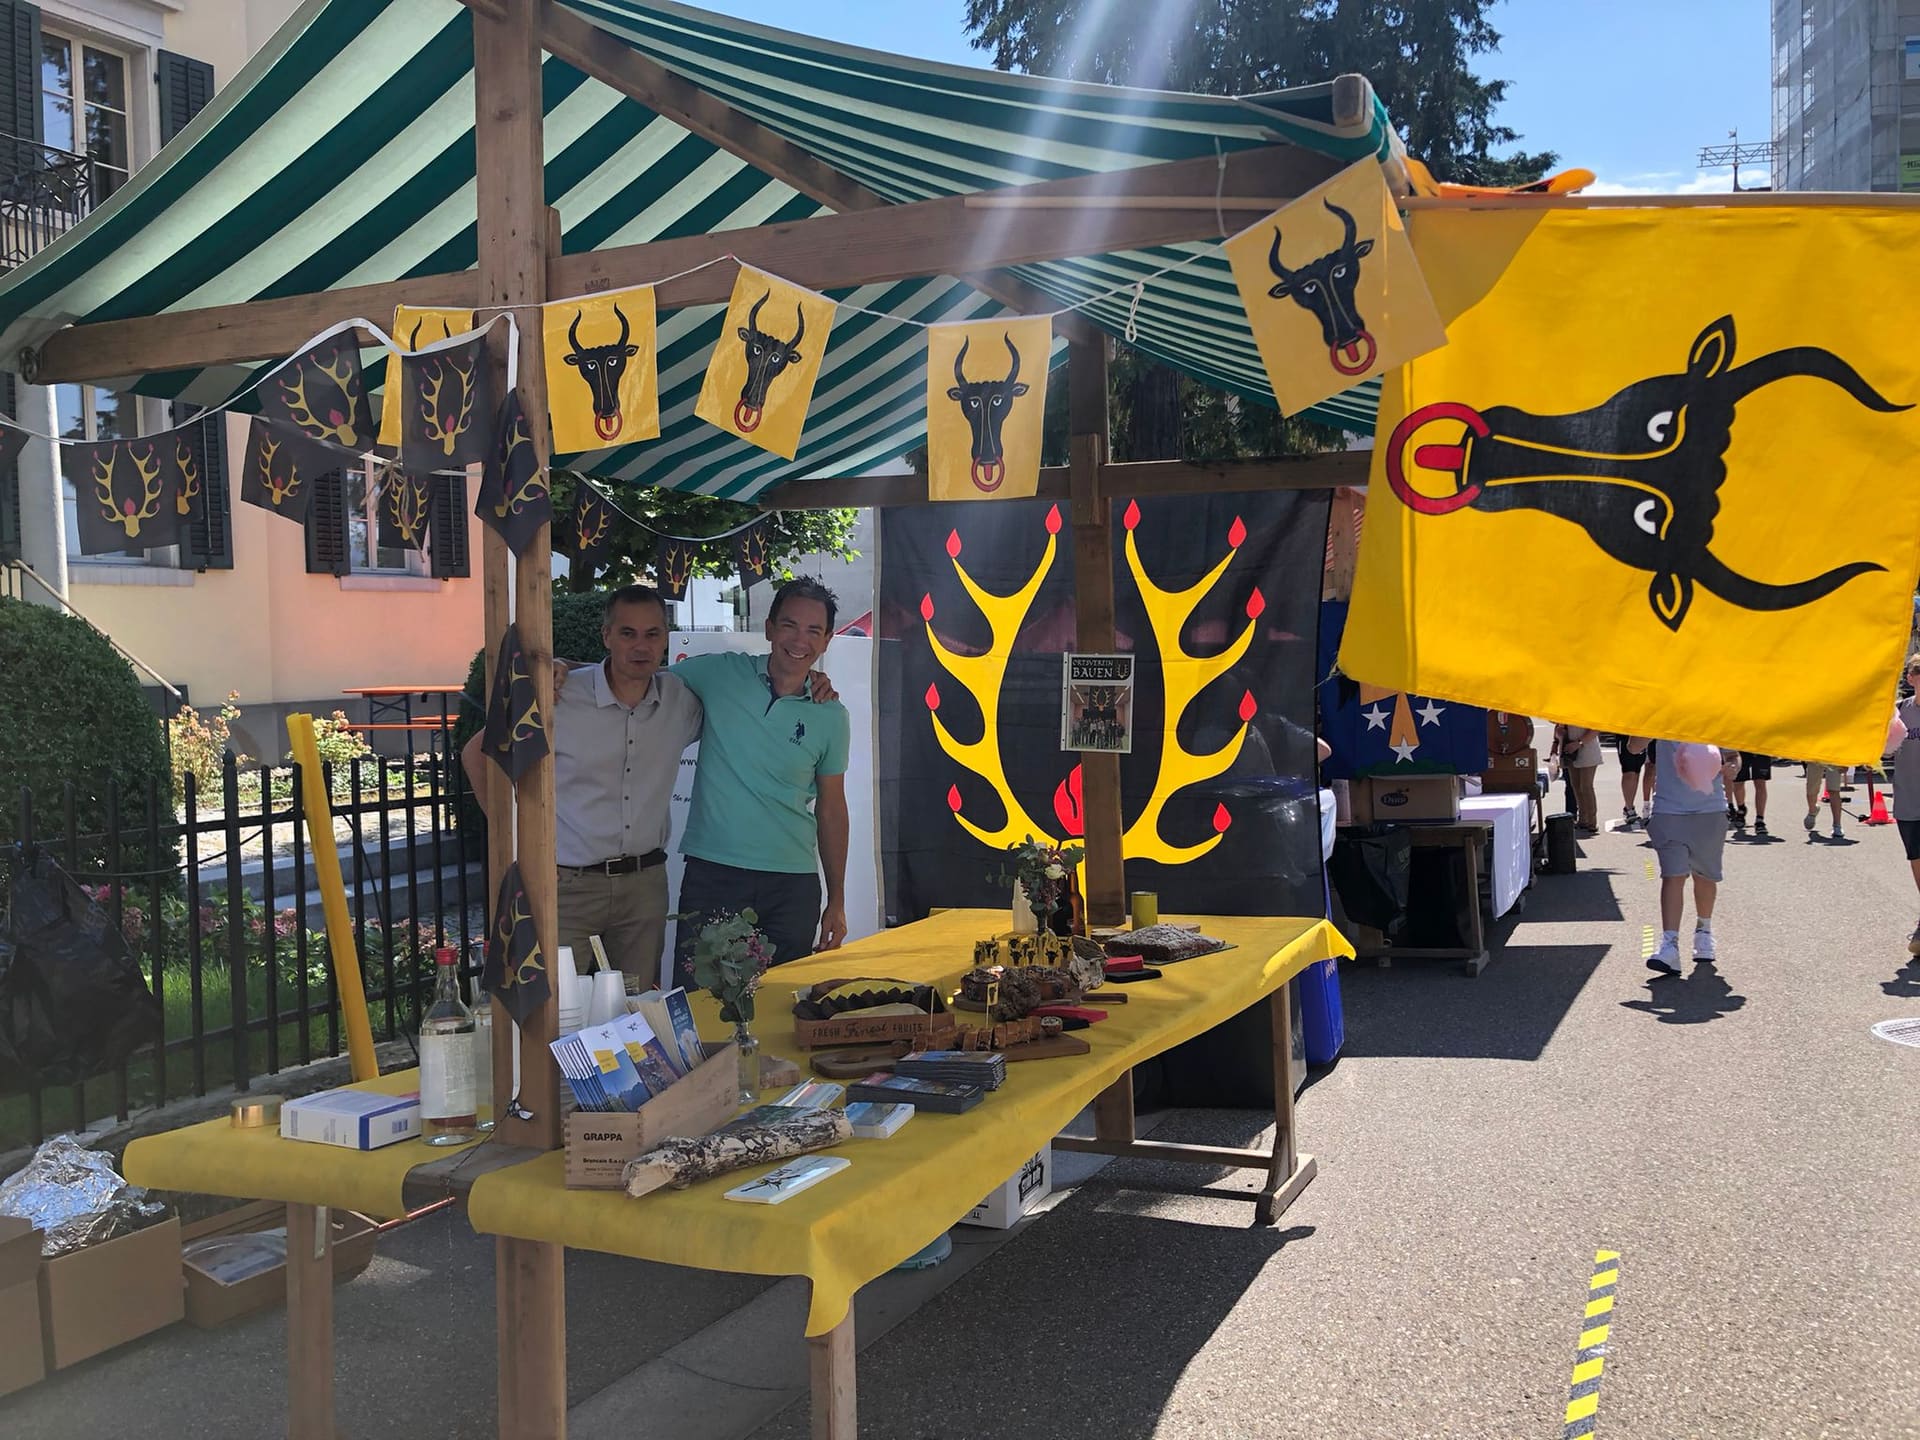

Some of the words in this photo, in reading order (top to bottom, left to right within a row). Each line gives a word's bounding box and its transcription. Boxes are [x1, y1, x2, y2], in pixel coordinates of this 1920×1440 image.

[1072, 667, 1113, 678] BAUEN
[812, 1028, 840, 1038] FRESH
[893, 1023, 922, 1034] FRUITS
[583, 1133, 623, 1141] GRAPPA
